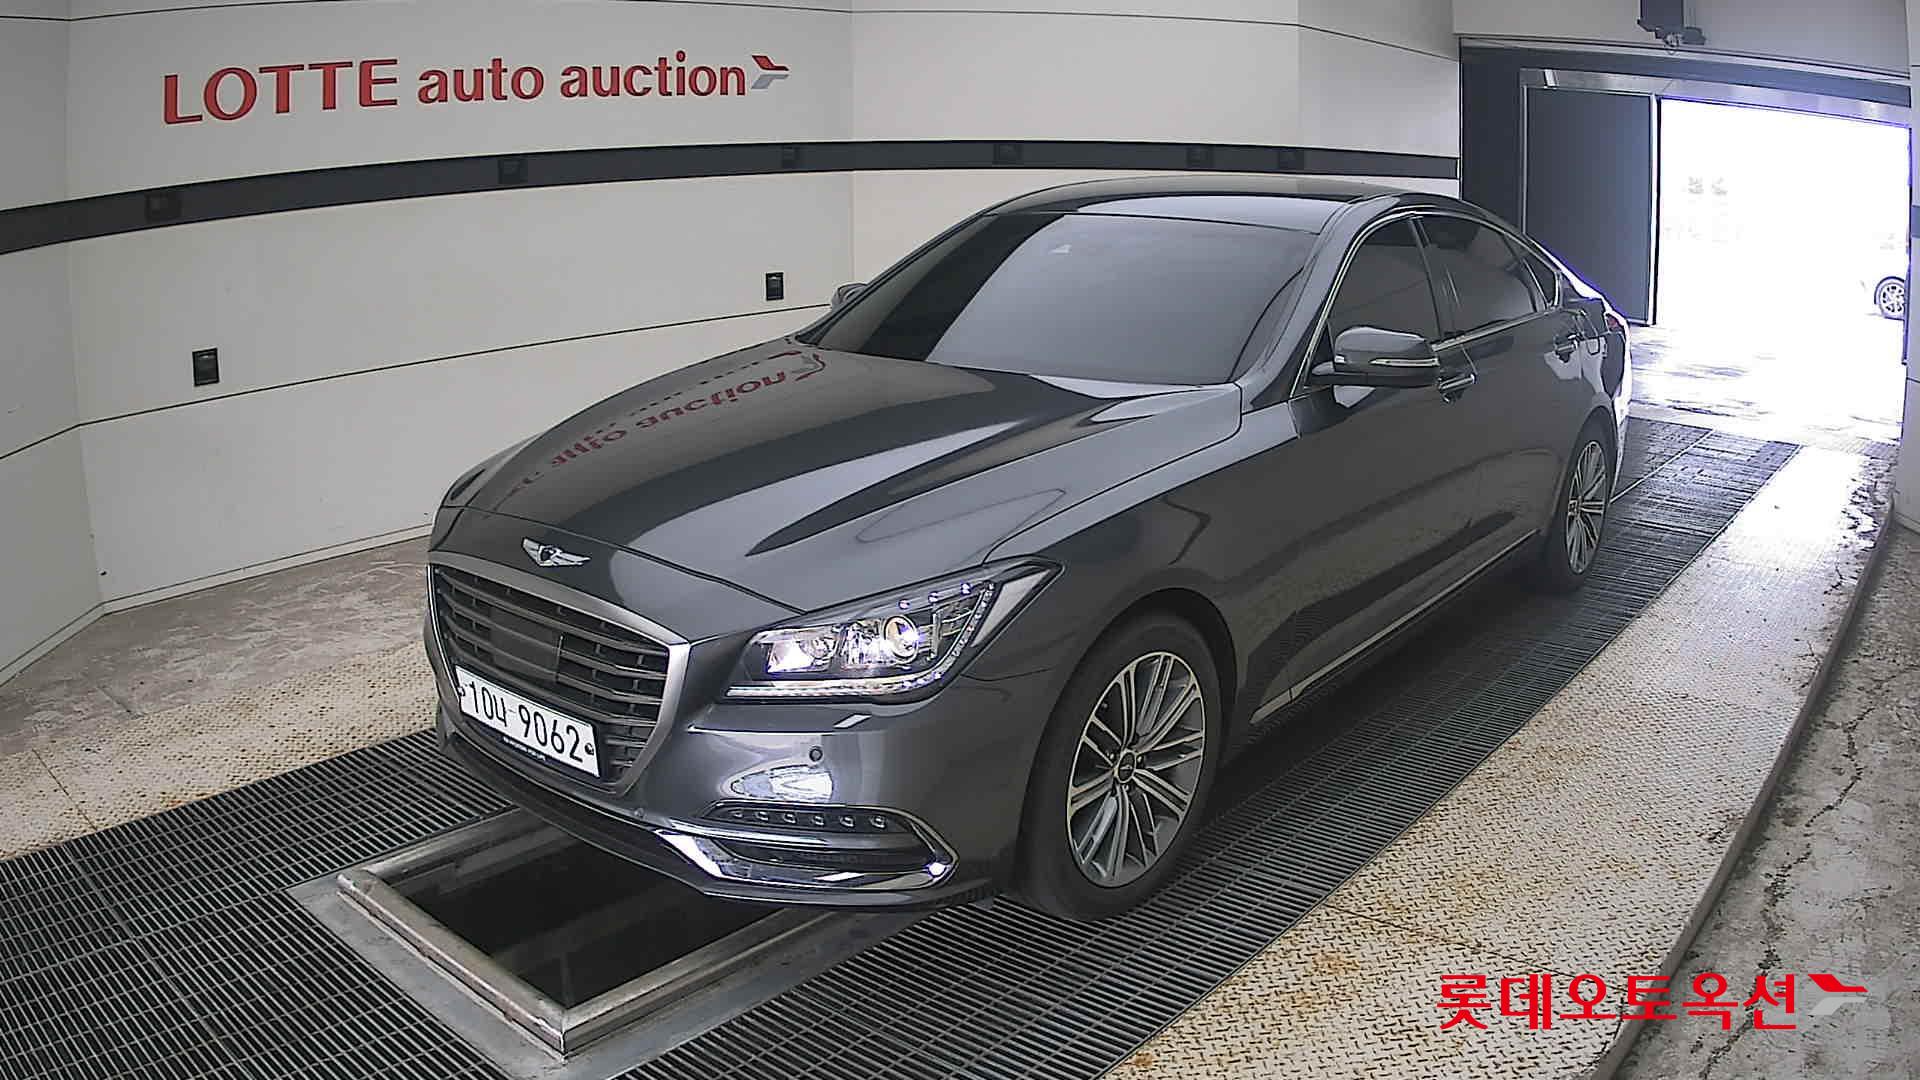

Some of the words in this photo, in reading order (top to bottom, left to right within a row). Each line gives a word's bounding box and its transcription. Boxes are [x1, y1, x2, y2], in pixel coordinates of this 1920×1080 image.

[163, 58, 398, 125] LOTTE
[417, 57, 544, 103] auto
[561, 50, 746, 97] auction
[518, 704, 584, 763] 9062
